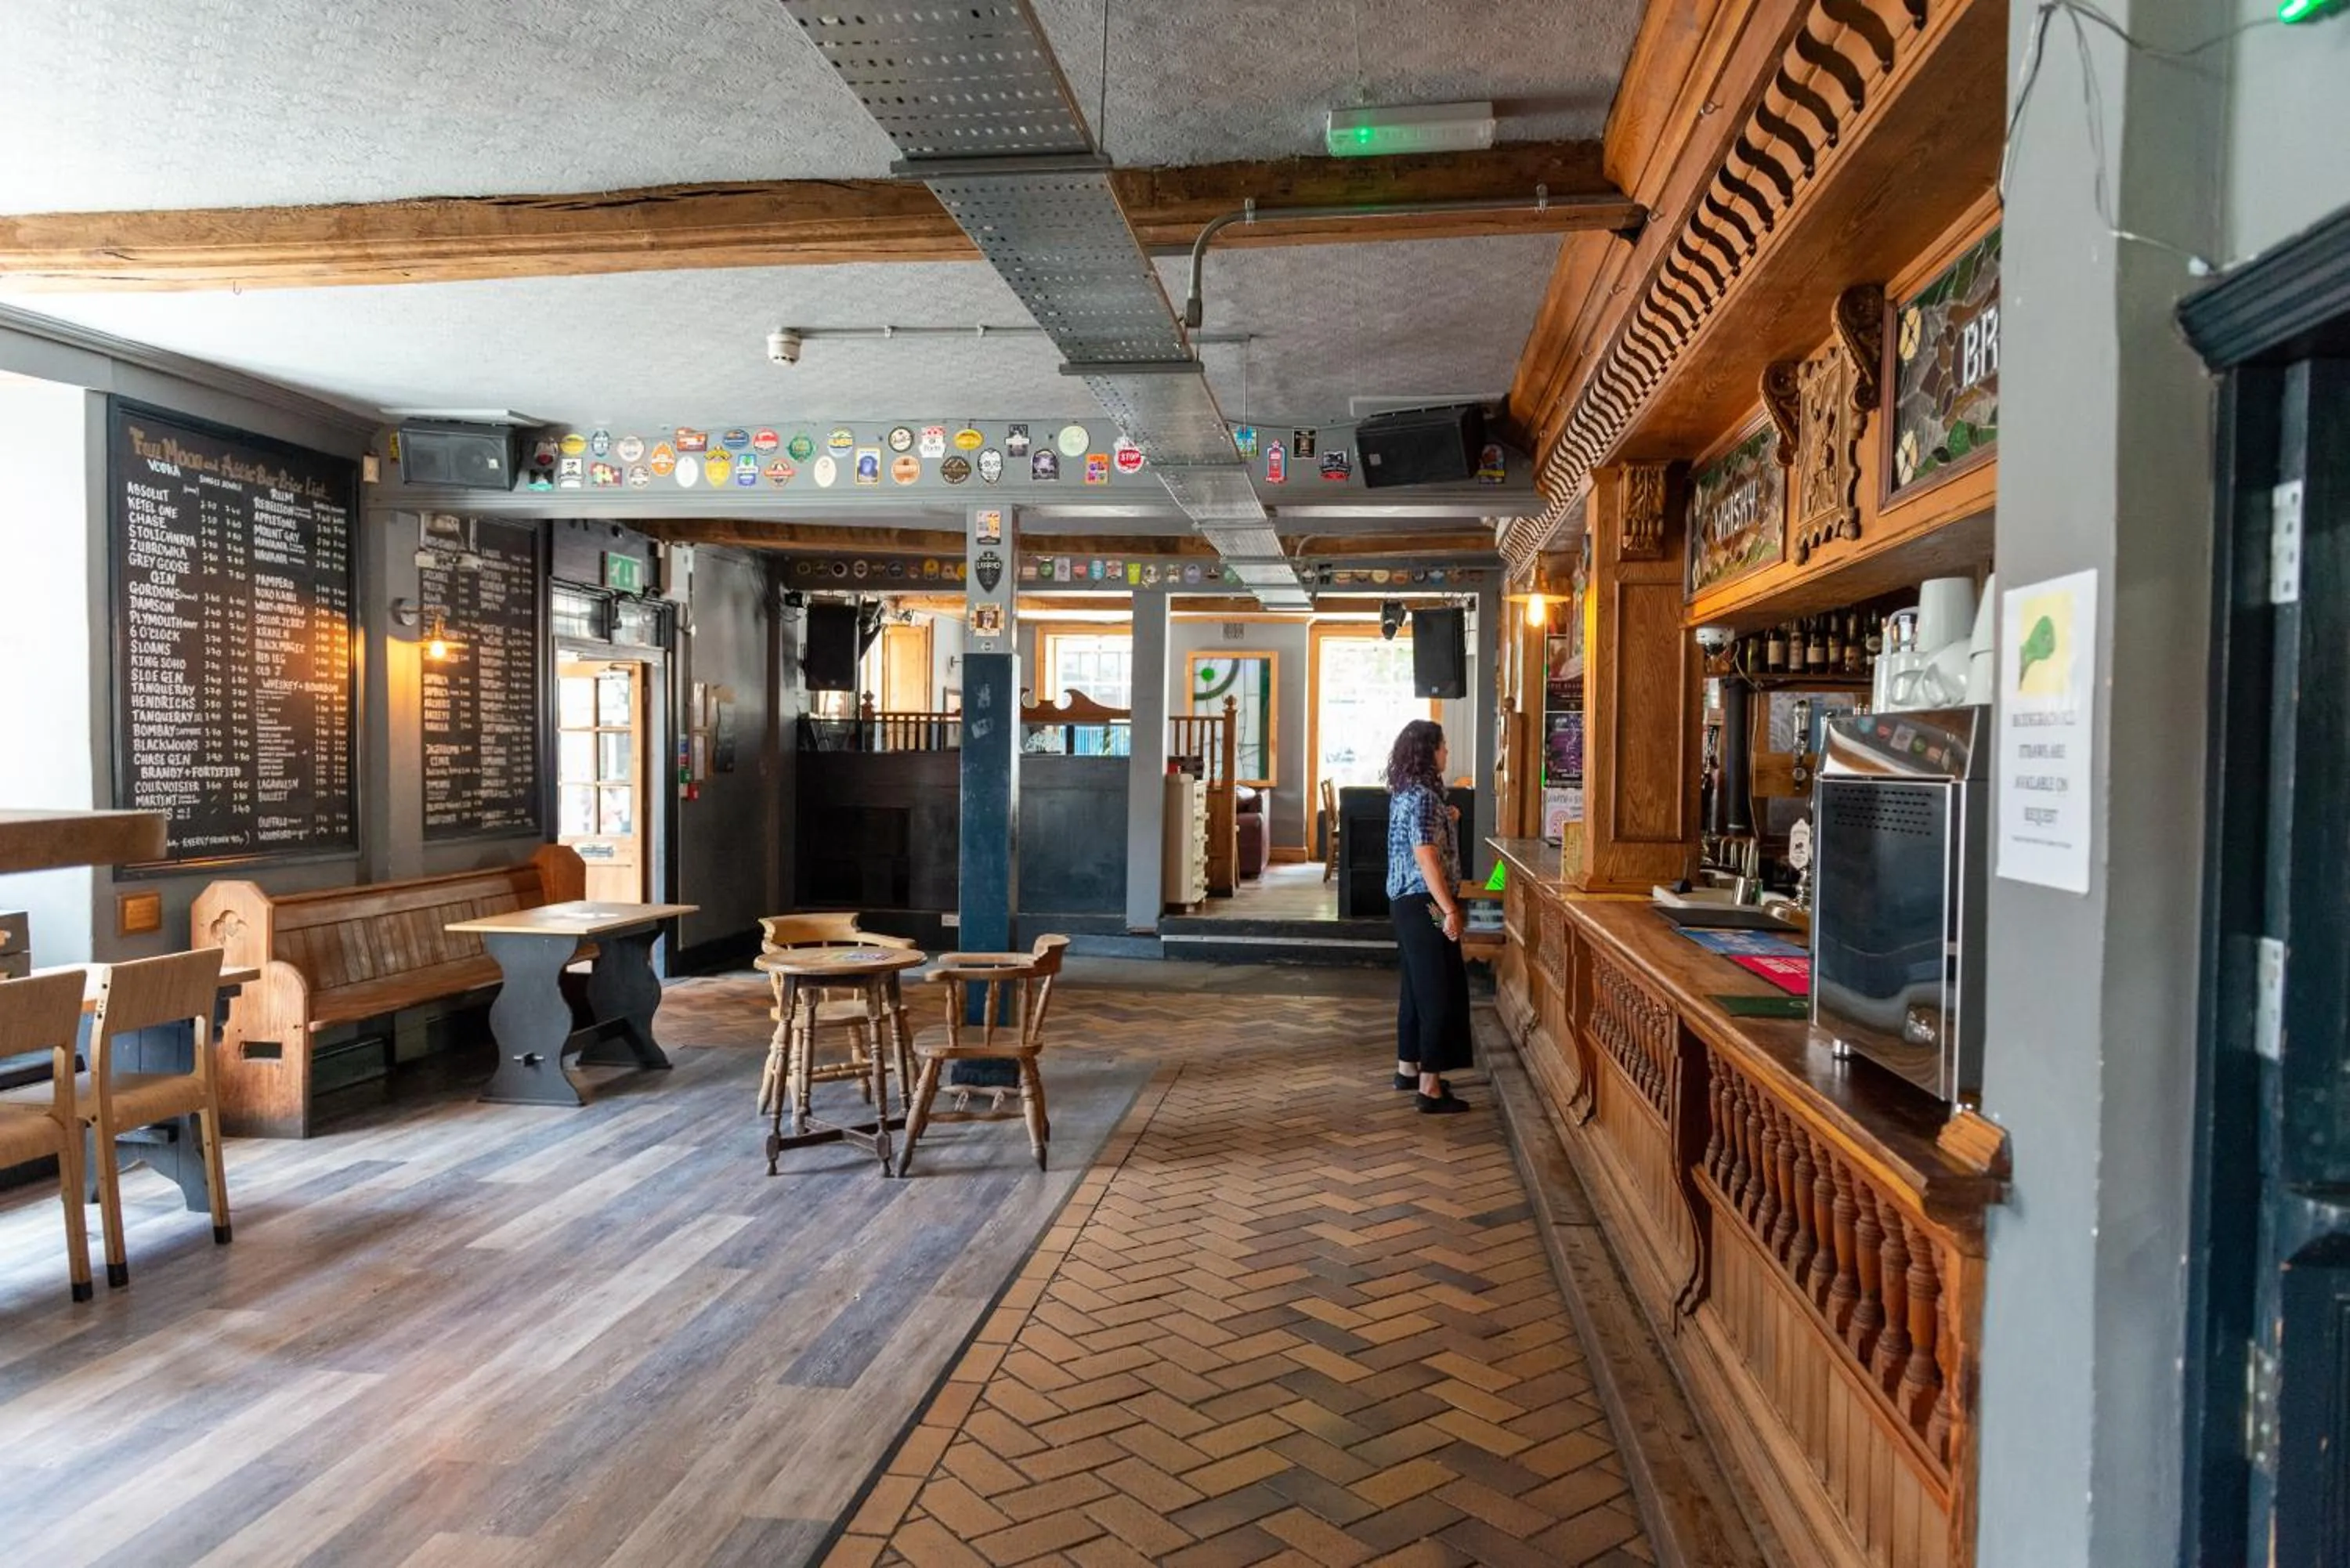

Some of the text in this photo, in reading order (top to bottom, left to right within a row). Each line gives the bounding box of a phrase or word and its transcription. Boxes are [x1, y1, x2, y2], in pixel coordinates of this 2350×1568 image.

[127, 481, 169, 502] ABSOLUT
[269, 488, 295, 504] RUM
[127, 496, 179, 519] KETEL ONE
[128, 511, 167, 529] CHASE
[128, 551, 190, 575] GREY GOOSE
[150, 570, 176, 585] GIN
[128, 580, 181, 602] GORDONS
[128, 595, 175, 614] DAMSON
[128, 610, 183, 629] PLYMOUTH
[129, 625, 138, 638] 6
[130, 638, 172, 656] SLOANS
[131, 654, 187, 670] KING SOHO
[161, 671, 184, 685] GIN
[131, 682, 195, 697] TANQUERAY
[131, 695, 196, 710] HENDRICKS
[132, 710, 193, 724] TANQUERAY
[132, 724, 176, 737] BOMBAY
[133, 752, 191, 765] CHASE GIN
[140, 766, 183, 779] BRANDY
[136, 794, 177, 807] MARTINI
